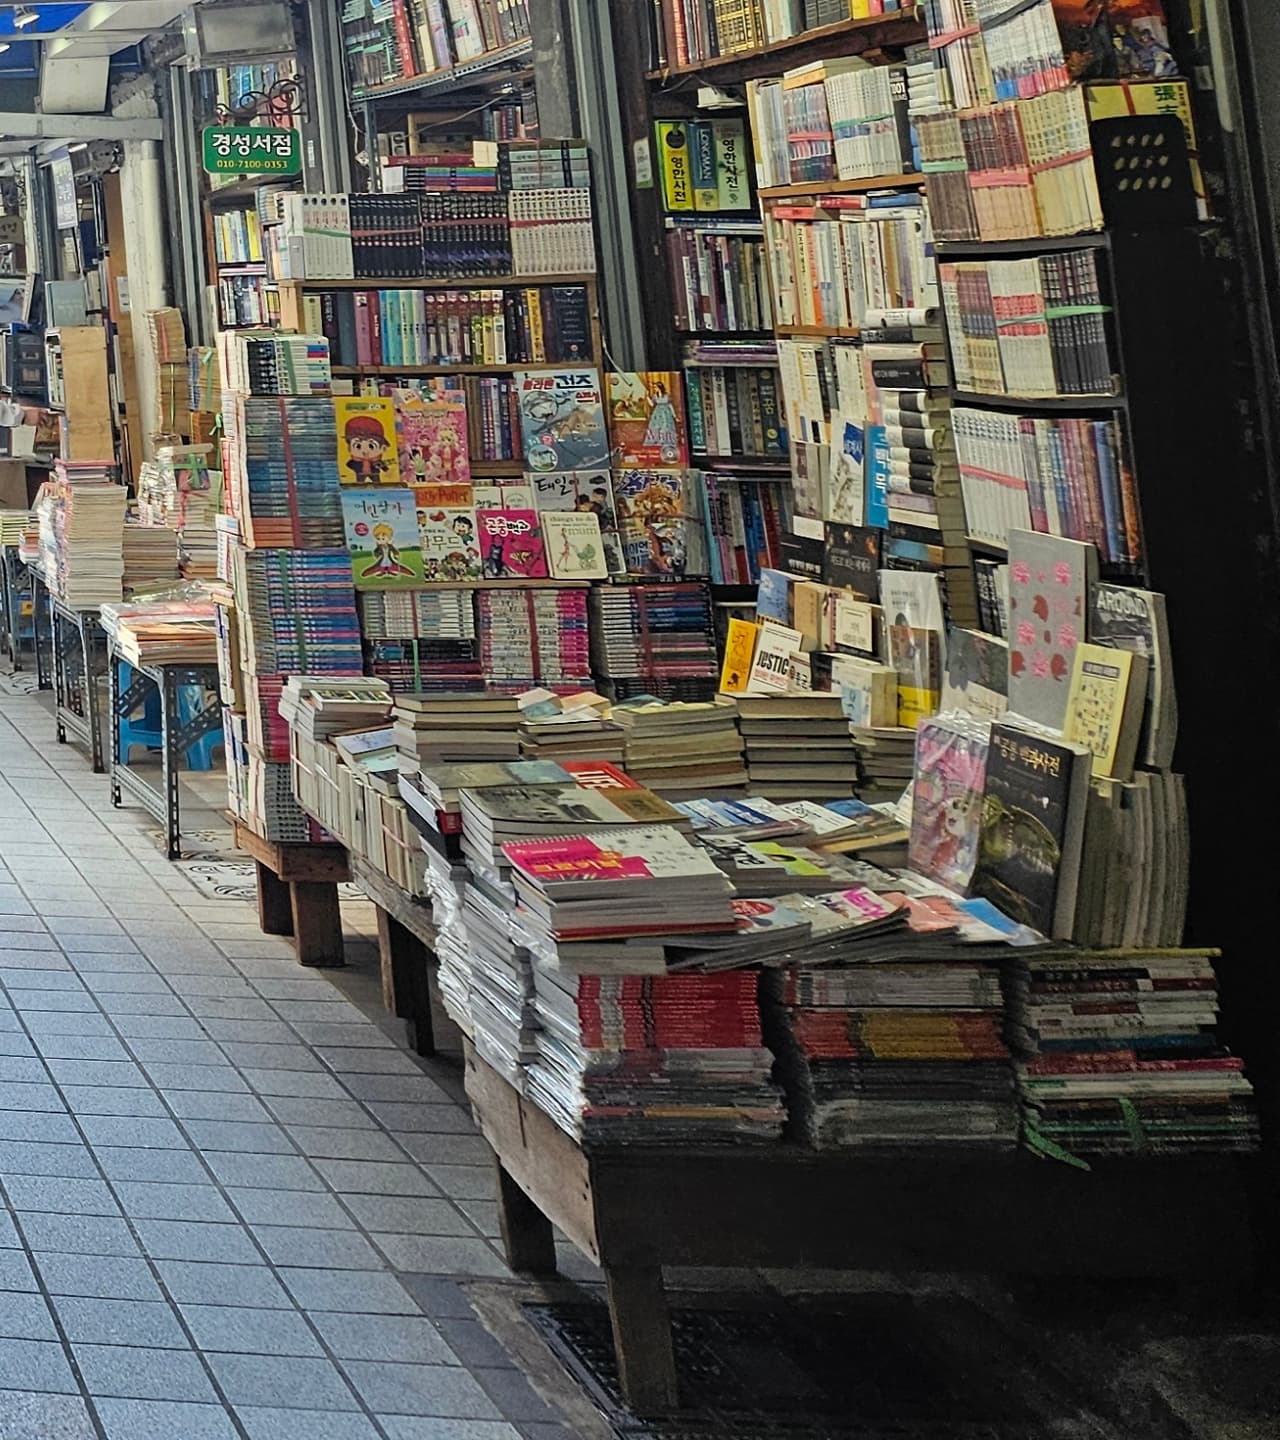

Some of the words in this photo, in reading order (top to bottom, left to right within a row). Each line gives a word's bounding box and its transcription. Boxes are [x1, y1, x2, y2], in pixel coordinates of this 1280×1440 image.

[211, 132, 293, 157] 경성서점
[698, 127, 712, 181] LONGMAN
[1095, 588, 1149, 619] AROUND
[756, 649, 790, 676] JUSTIC
